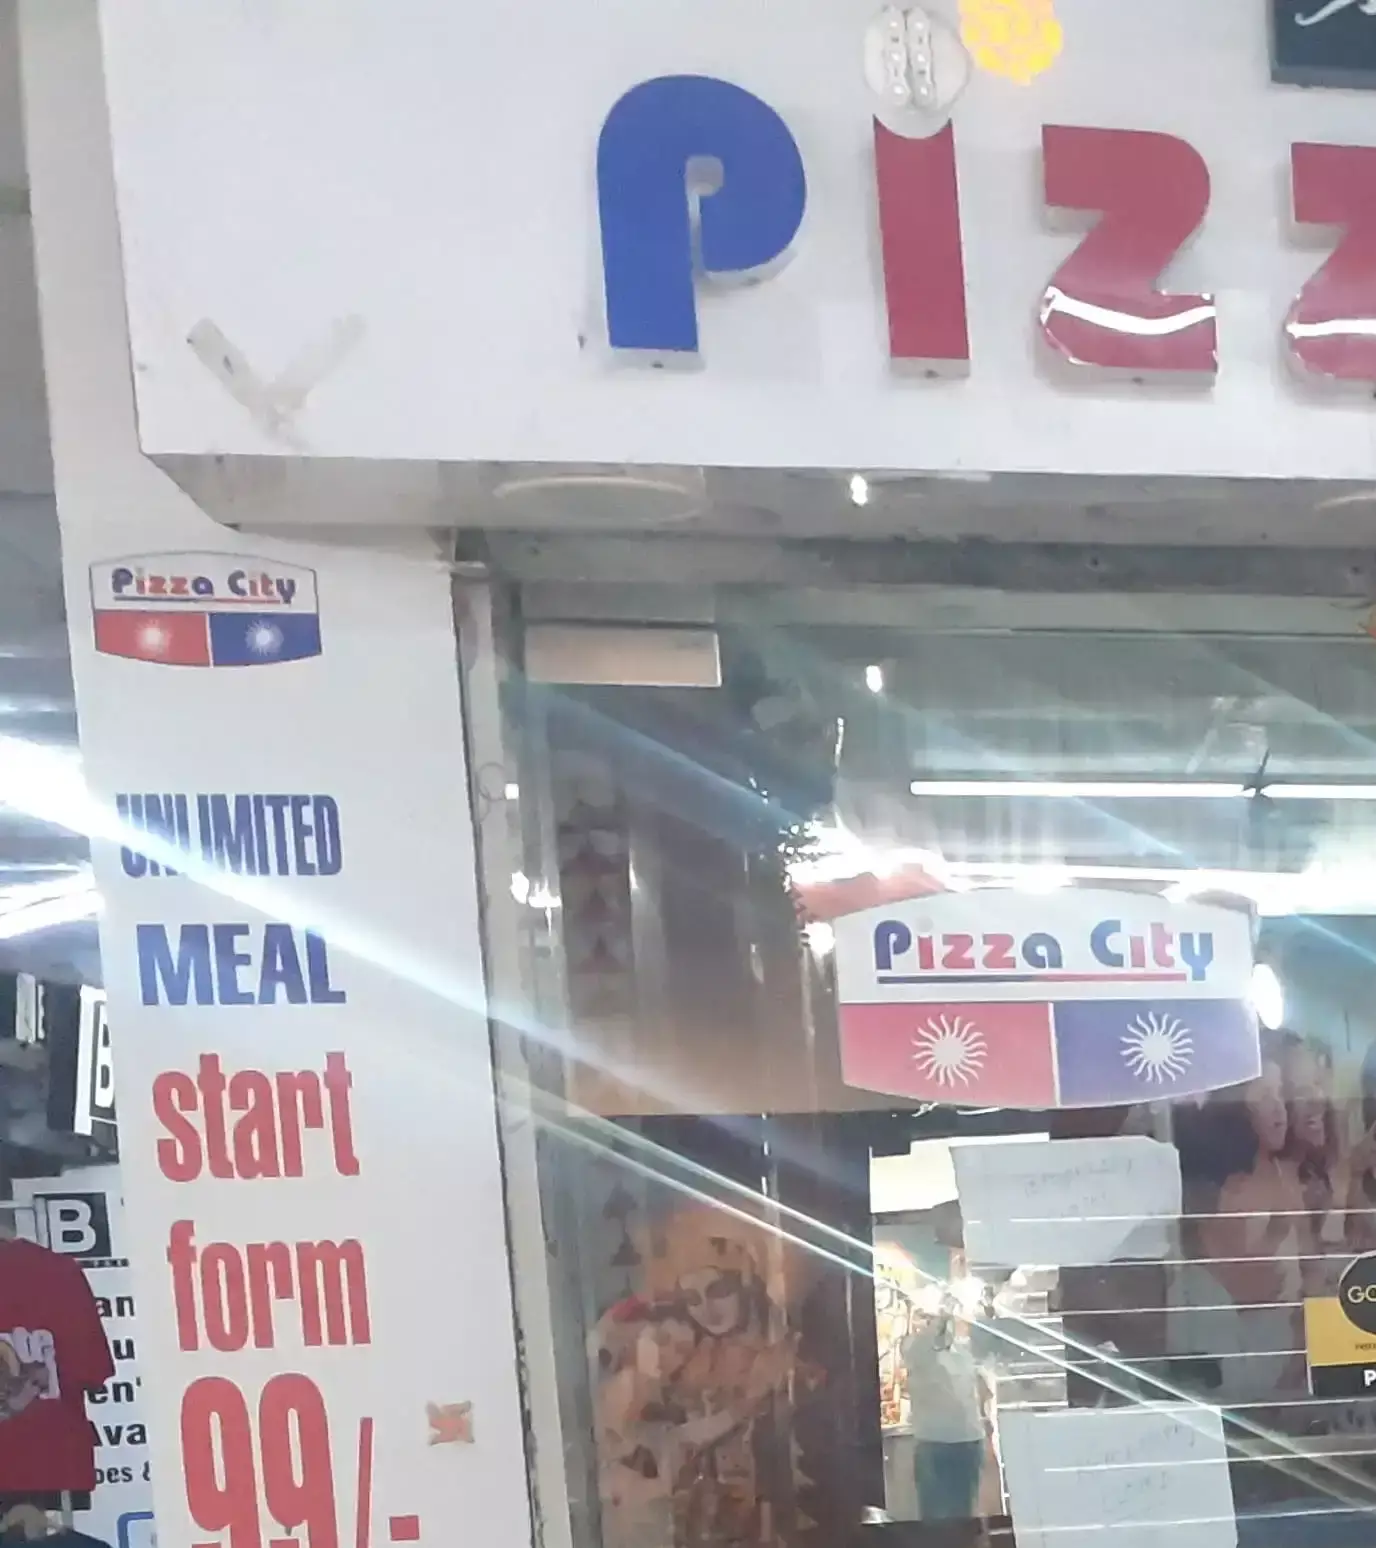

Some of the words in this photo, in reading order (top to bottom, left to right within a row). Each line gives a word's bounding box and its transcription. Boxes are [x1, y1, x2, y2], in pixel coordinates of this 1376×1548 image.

[112, 566, 215, 595] Pizza
[227, 568, 297, 604] City
[116, 793, 344, 879] UNLIMITED
[135, 923, 347, 1007] MEAL
[874, 915, 1063, 971] Pizza
[1090, 919, 1214, 982] City
[152, 1052, 360, 1183] start
[167, 1220, 372, 1352] form
